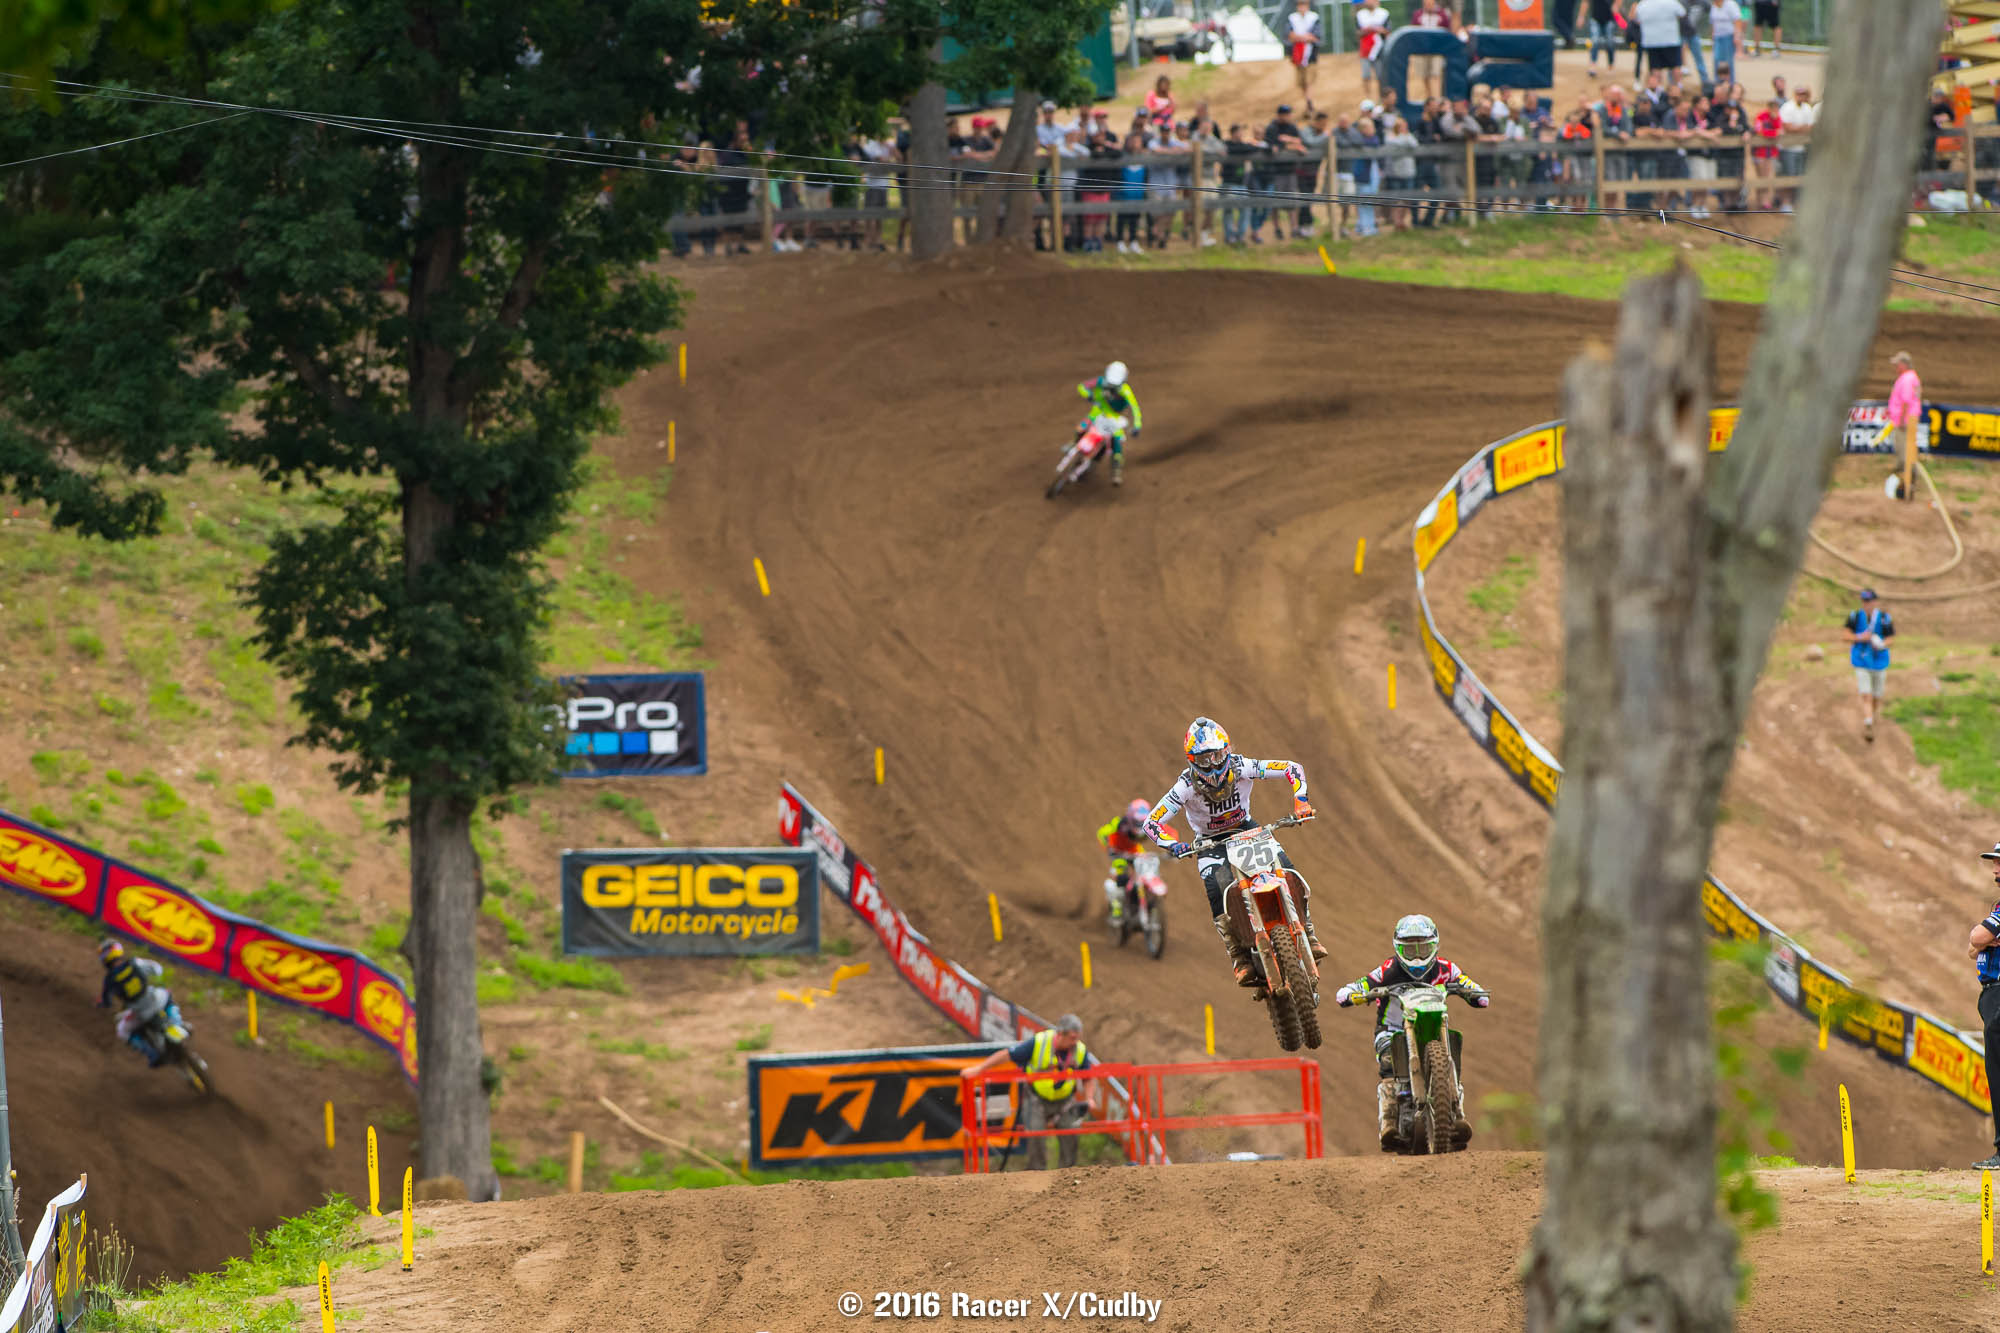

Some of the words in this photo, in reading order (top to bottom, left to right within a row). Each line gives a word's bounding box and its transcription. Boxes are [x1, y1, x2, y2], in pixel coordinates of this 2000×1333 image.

[1237, 841, 1274, 872] 25
[582, 864, 799, 908] GEICO
[118, 889, 215, 942] FMF
[630, 908, 799, 940] Motorcycle
[242, 942, 340, 988] FMF
[769, 1068, 1011, 1149] KTM
[322, 1275, 330, 1312] ACERBIS
